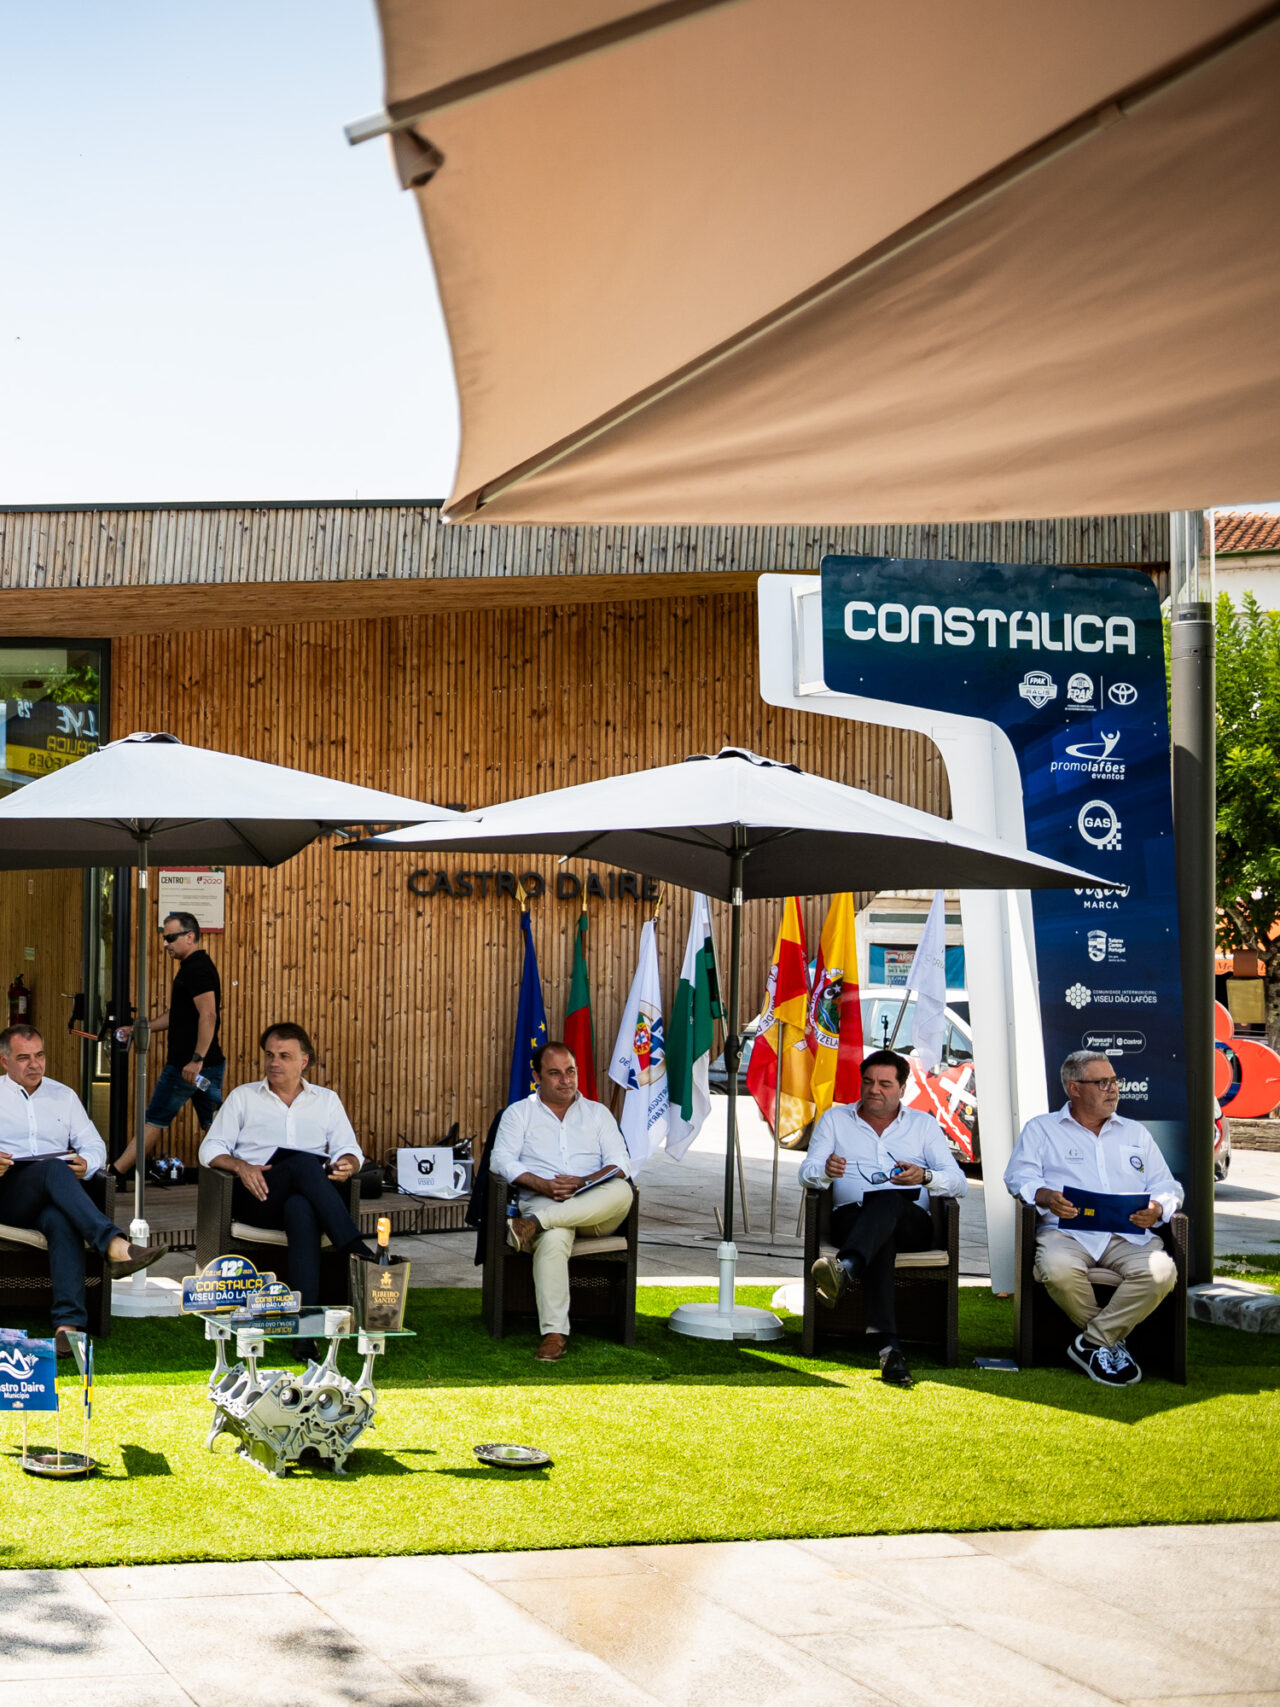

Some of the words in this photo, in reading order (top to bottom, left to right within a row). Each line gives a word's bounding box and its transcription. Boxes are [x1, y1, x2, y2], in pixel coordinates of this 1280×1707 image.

[844, 601, 1136, 655] CONSTALICA
[1029, 677, 1046, 685] FPAK
[1067, 688, 1093, 700] FPAK
[1050, 761, 1126, 773] promolafões
[1091, 772, 1125, 780] eventos
[1084, 817, 1112, 828] GAS
[161, 876, 184, 885] CENTRO
[408, 869, 546, 898] CASTRO
[556, 872, 660, 900] DAIRE
[1083, 901, 1119, 909] MARCA
[1093, 995, 1113, 1003] VISEU
[1115, 994, 1130, 1003] DÃO
[1131, 994, 1158, 1004] LAFÕES
[195, 1278, 263, 1293] CONSTALICA
[189, 1292, 214, 1302] VISEU
[216, 1290, 234, 1301] DÃO
[236, 1288, 261, 1299] LAFÕ
[371, 1290, 400, 1298] RIBEIRO
[20, 1381, 46, 1393] Daire
